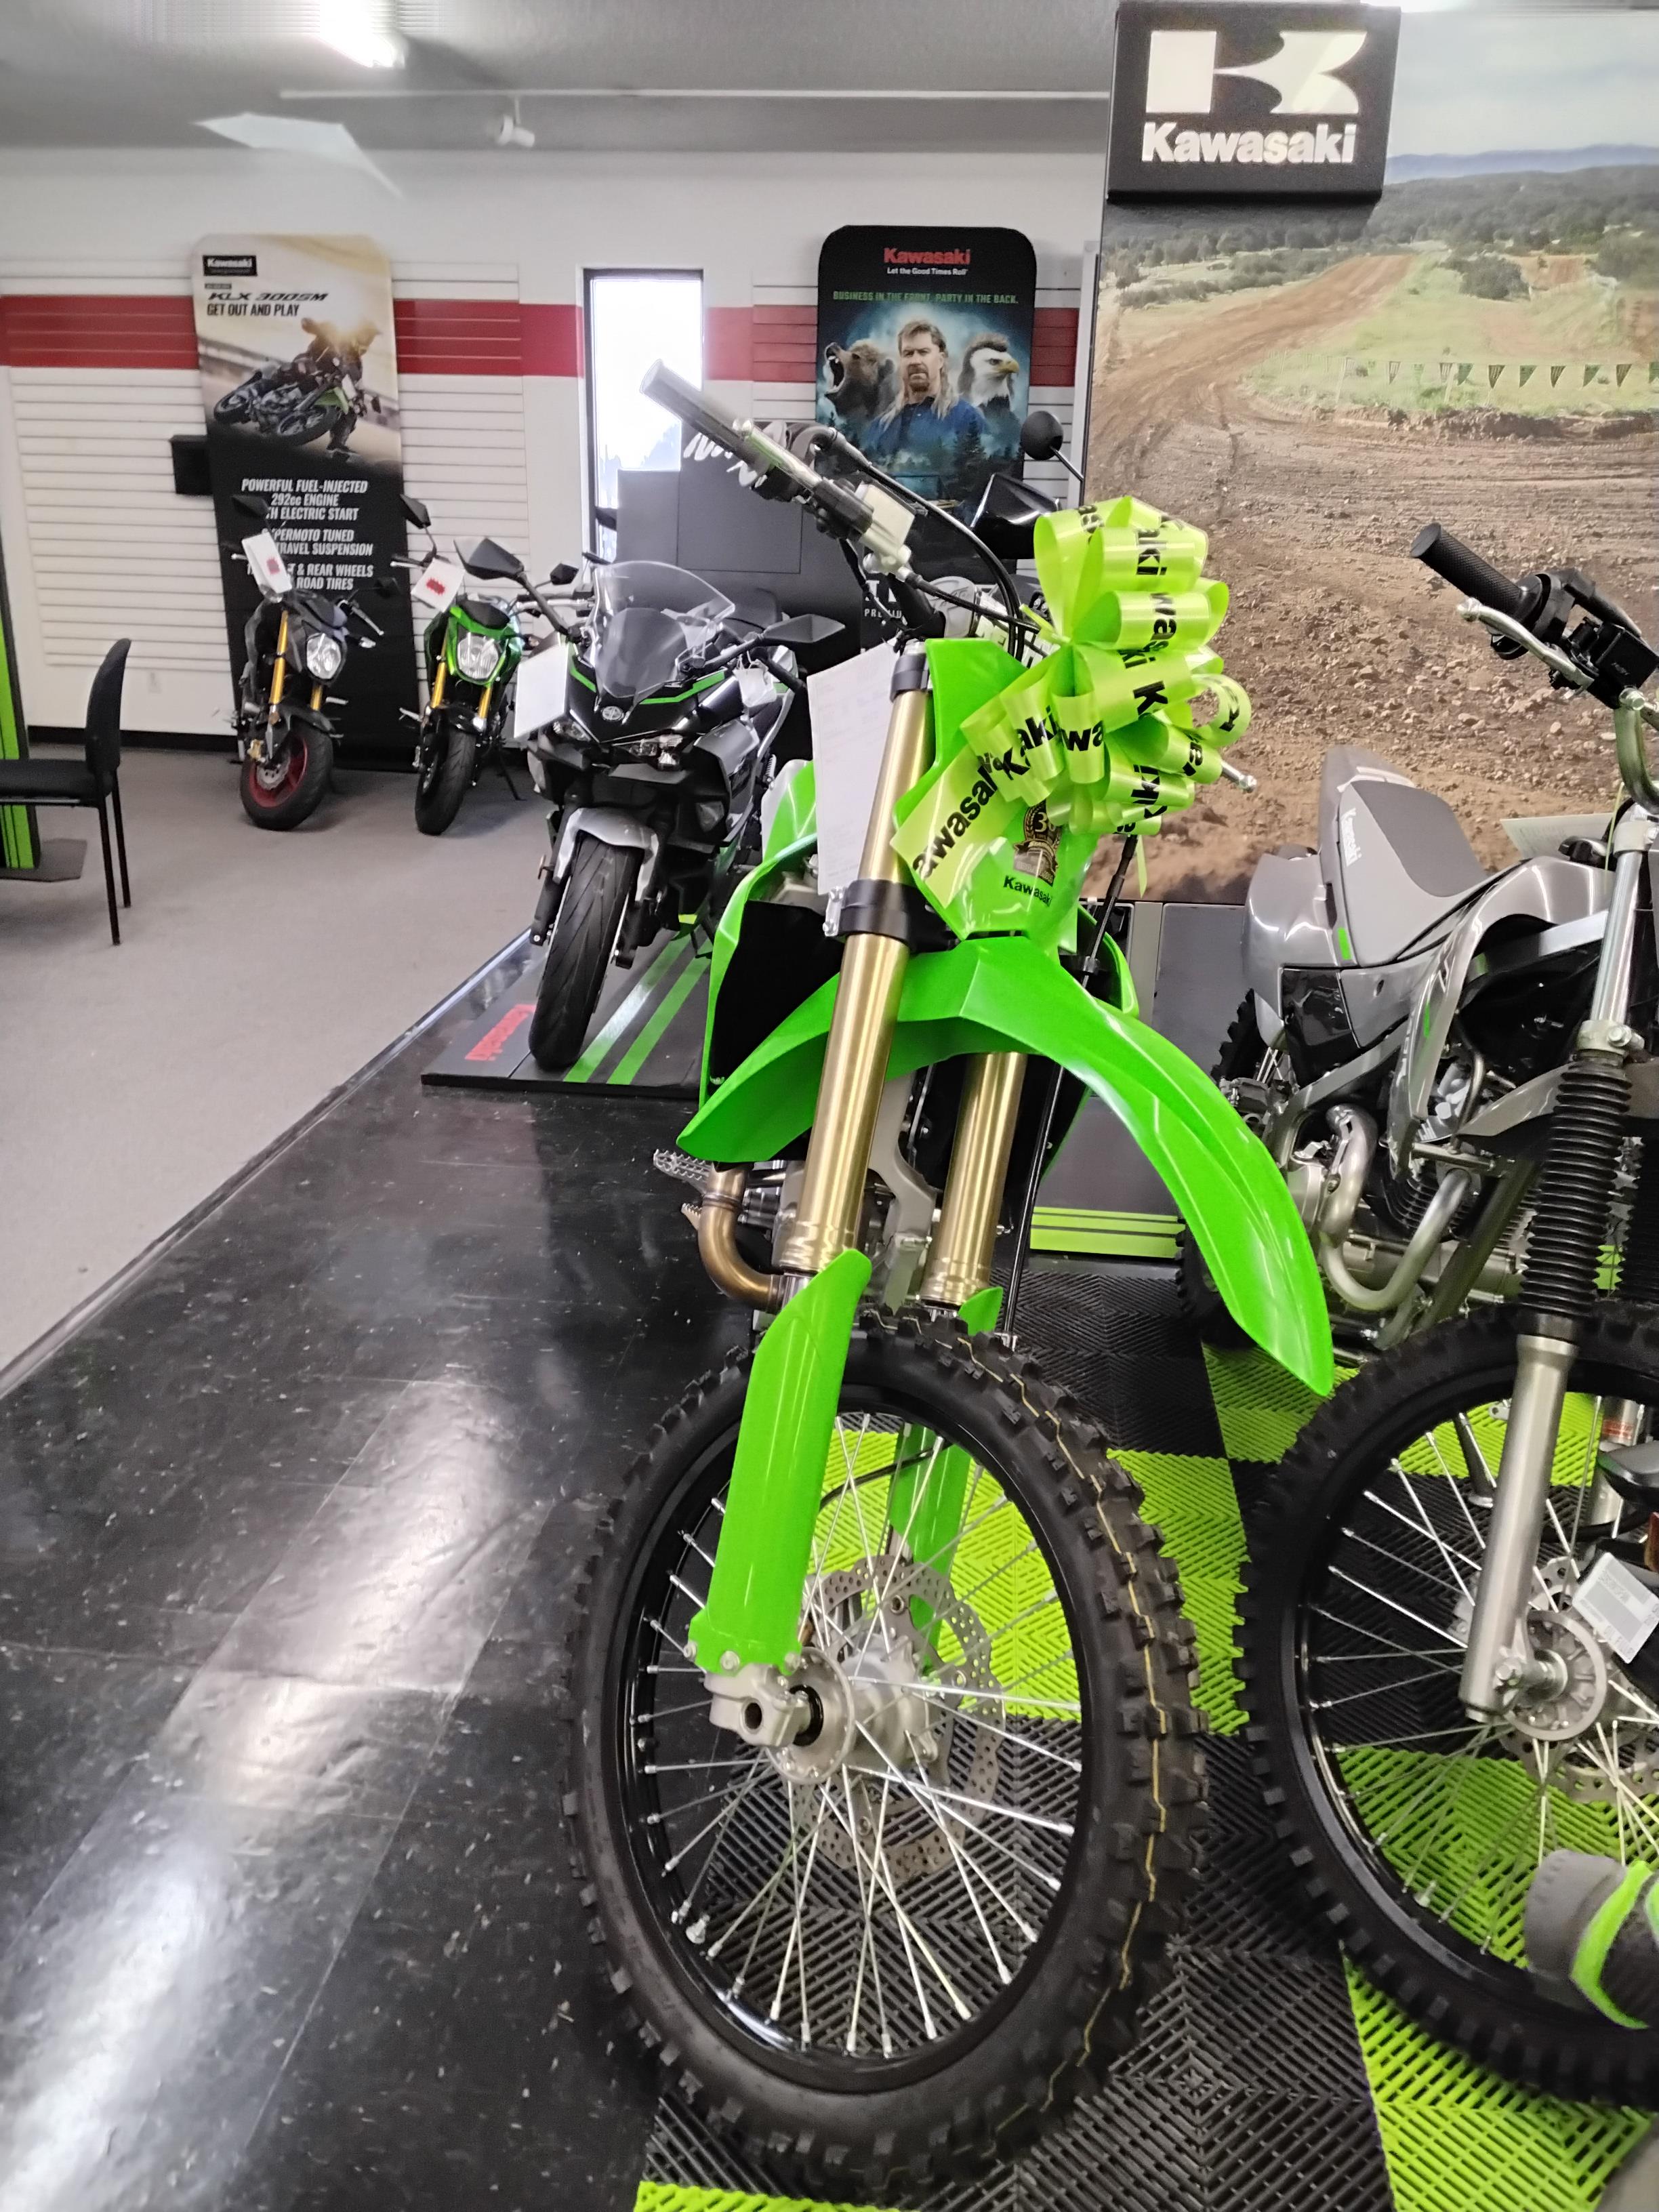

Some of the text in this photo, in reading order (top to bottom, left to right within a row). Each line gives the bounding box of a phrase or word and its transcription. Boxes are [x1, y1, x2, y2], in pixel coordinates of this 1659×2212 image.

[1142, 122, 1357, 164] Kawasaki
[884, 247, 970, 265] Kawasaki
[207, 292, 329, 302] KLX 300SM
[833, 290, 874, 301] BUSINESS
[887, 292, 902, 302] THE
[935, 293, 962, 303] PARTY
[965, 293, 973, 303] IN
[976, 294, 991, 304] THE
[207, 303, 300, 316] GET OUT AND PLAY
[241, 478, 369, 493] POWERFUL FUEL-INJECTED
[271, 493, 340, 507] 292cc ENGINE
[280, 506, 327, 520] ELECTRIC
[327, 508, 360, 521] START
[262, 528, 355, 542] PERMOTO TUNED
[312, 543, 374, 556] SUSPENSION
[297, 563, 305, 576] &
[306, 563, 333, 576] REAR
[335, 564, 375, 577] WHEELS
[295, 577, 354, 590] ROAD TIRES
[1003, 874, 1052, 907] Kawasaki
